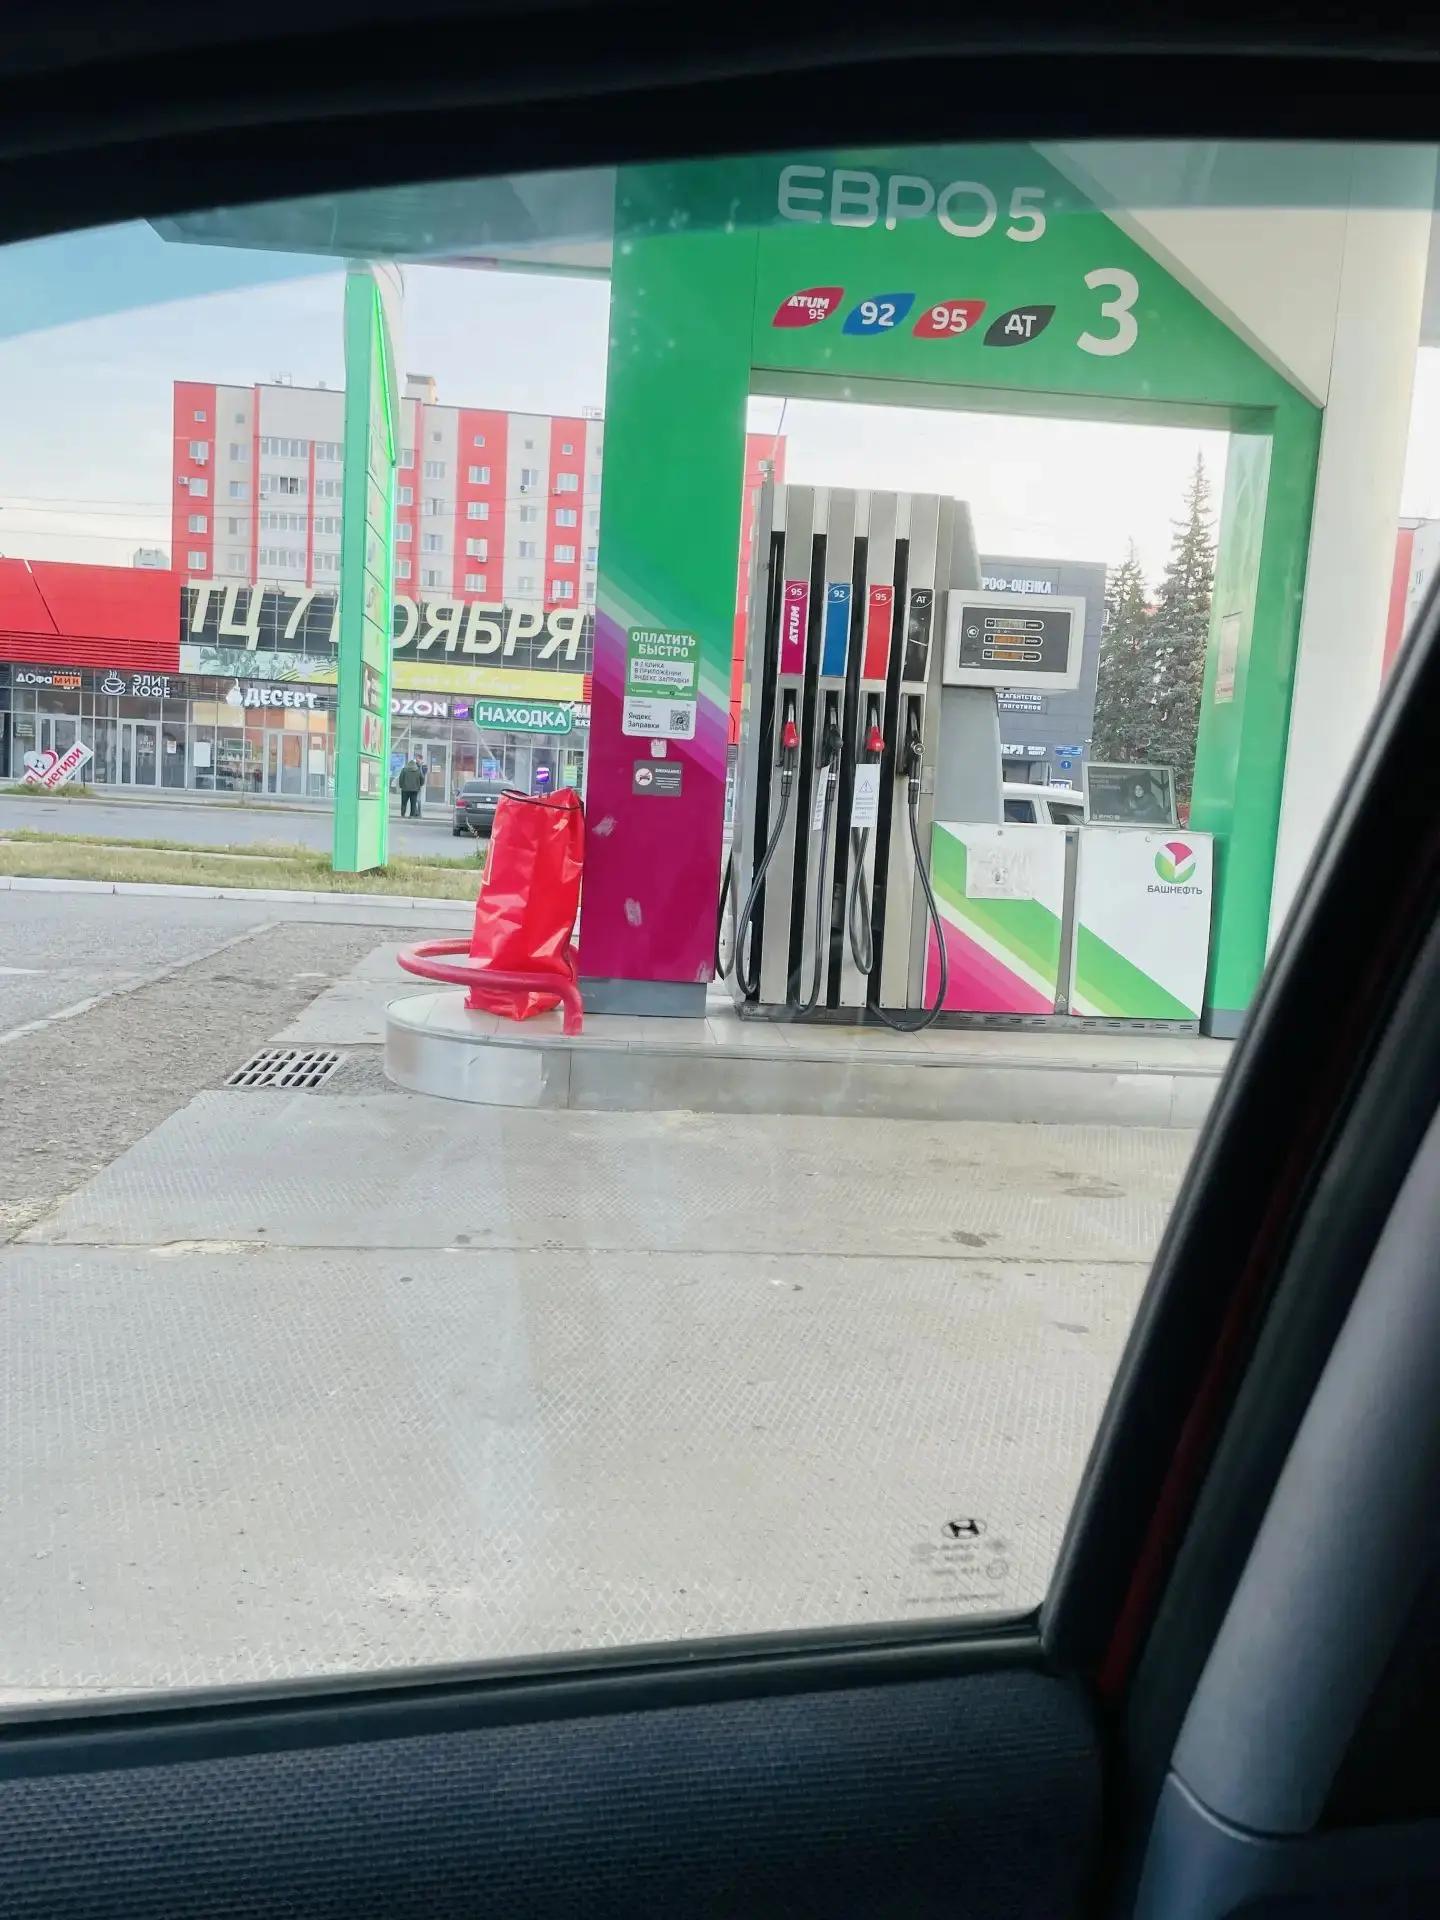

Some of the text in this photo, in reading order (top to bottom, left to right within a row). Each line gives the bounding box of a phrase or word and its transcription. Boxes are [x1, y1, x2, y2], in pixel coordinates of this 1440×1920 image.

[777, 164, 1047, 243] ЕВРО 5
[787, 295, 830, 309] ATUM
[808, 308, 825, 320] 95
[859, 301, 896, 327] 92
[930, 306, 968, 333] 95
[1076, 267, 1140, 357] 3
[790, 588, 803, 596] 95
[982, 576, 1052, 595] РОФ-ОЦЕНКА
[833, 589, 845, 598] 92
[875, 592, 887, 601] 95
[187, 578, 586, 661] ТЦ 7 ОЯБРЯ
[788, 605, 800, 645] ATUM
[632, 631, 696, 646] ОПЛАТИТЬ
[638, 643, 689, 658] БЫСТРО
[132, 674, 170, 687] ЭЛИТ
[132, 685, 171, 698] КОФЕ
[243, 687, 318, 709] ДЕСЕРТ
[478, 705, 568, 729] НАХОДКА
[628, 712, 652, 721] Яндекс
[628, 721, 660, 730] Заправки
[1147, 885, 1203, 895] БАШНЕФТЬ
